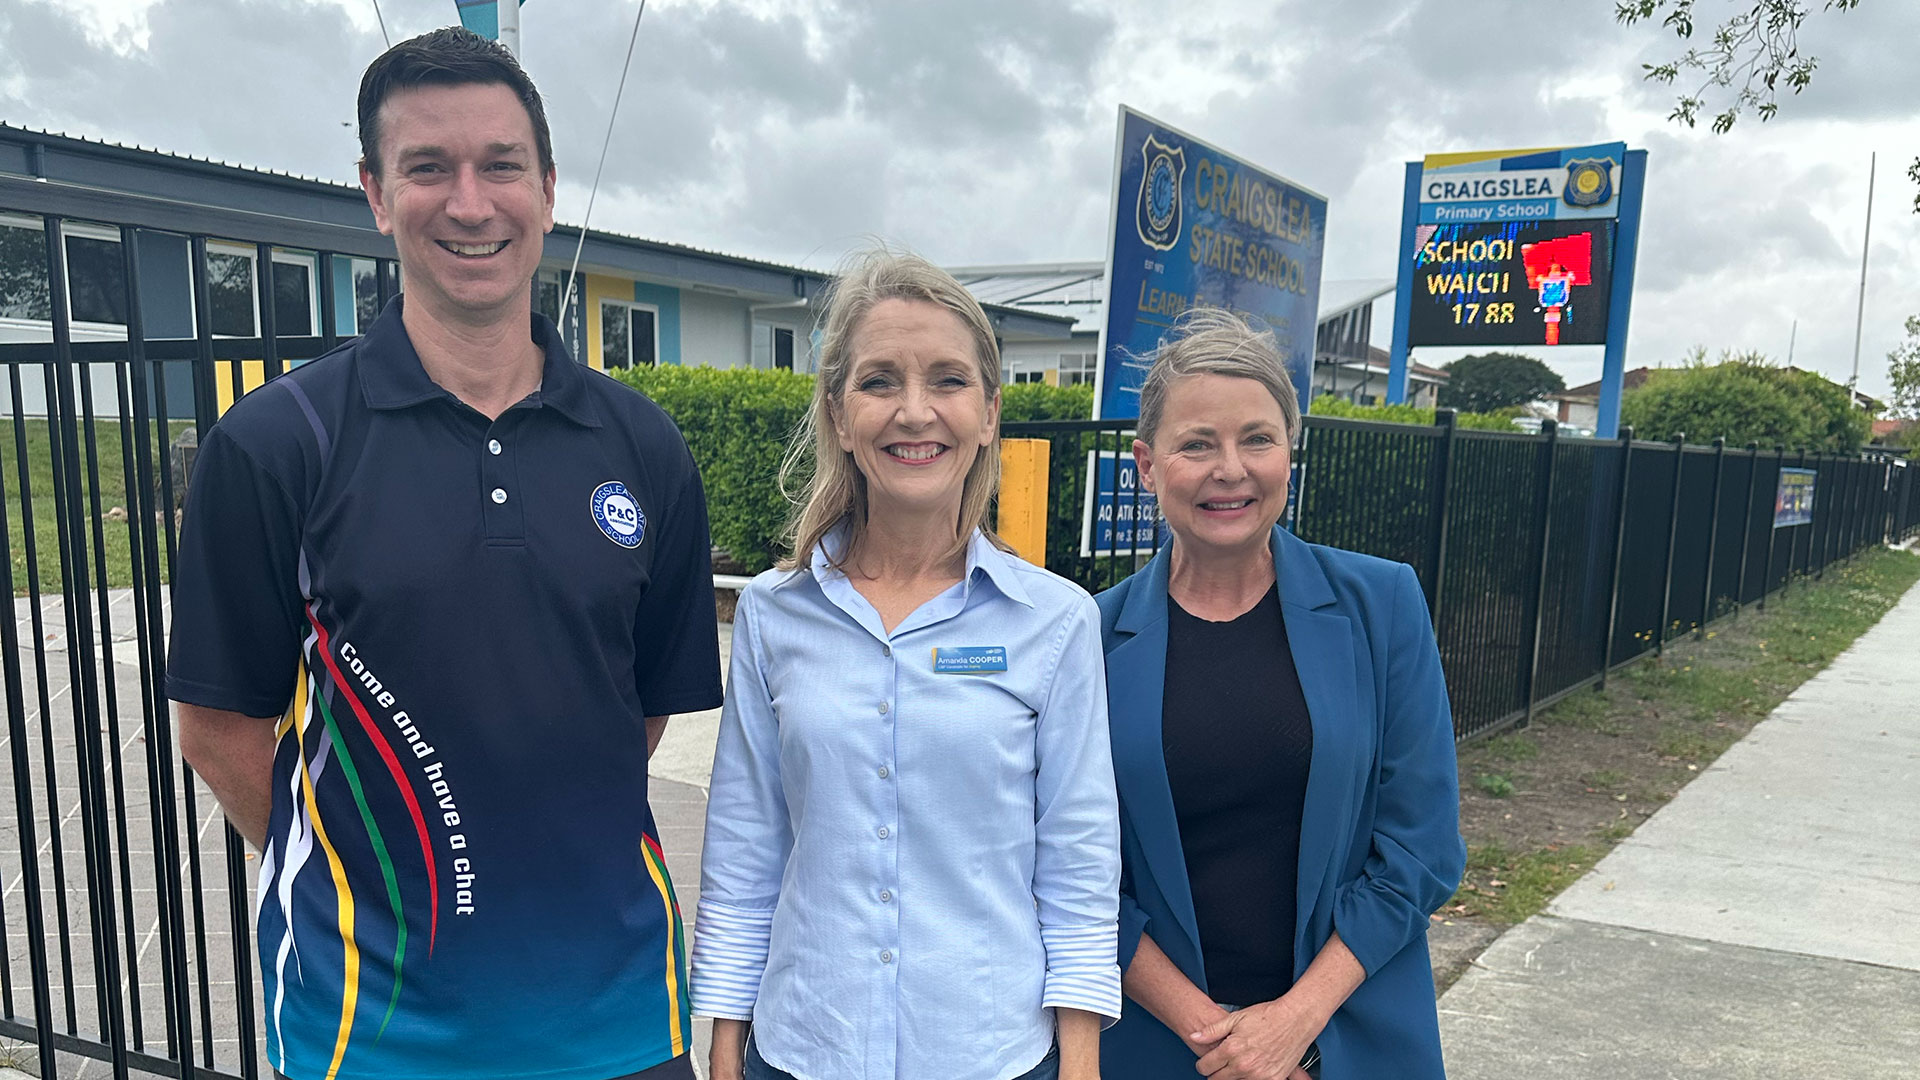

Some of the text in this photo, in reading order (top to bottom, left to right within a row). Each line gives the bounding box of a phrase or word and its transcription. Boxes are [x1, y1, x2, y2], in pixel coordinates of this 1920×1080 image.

[1428, 177, 1553, 200] CRAIGSLEA
[1194, 158, 1311, 248] CRAIGSLEA
[1435, 203, 1549, 220] Primary School
[1189, 224, 1307, 296] STATE SCHOOL
[1120, 468, 1141, 489] OU
[594, 485, 629, 520] CRAIGSLEA
[607, 503, 634, 521] P&C
[1098, 504, 1142, 522] AQATICS
[605, 526, 640, 545] SCHOOL
[969, 656, 1003, 664] COOPER
[340, 641, 476, 915] Come and have a chat
